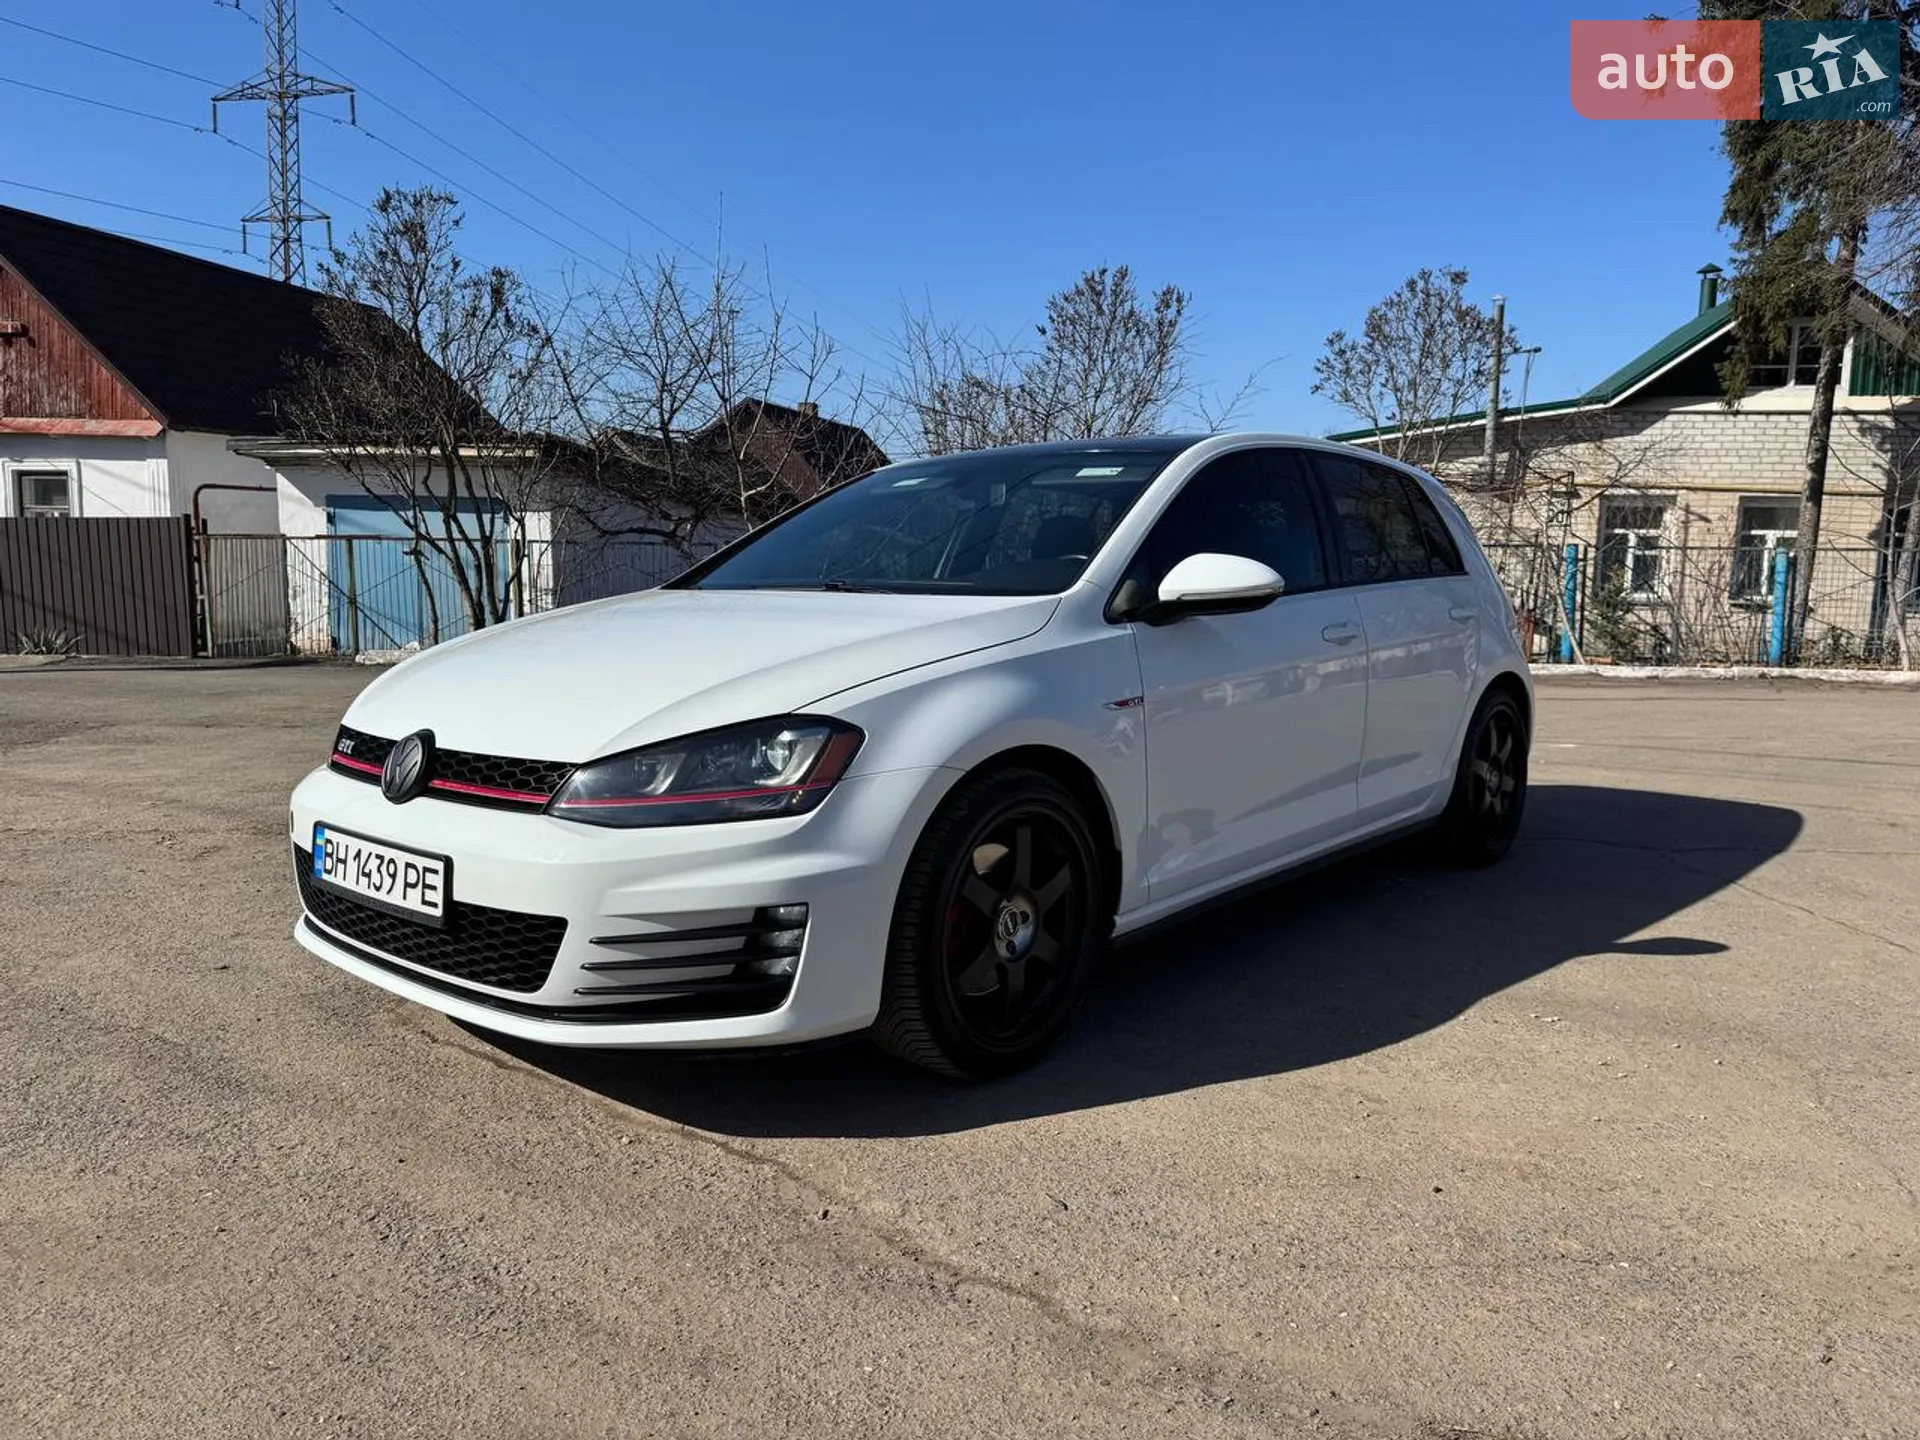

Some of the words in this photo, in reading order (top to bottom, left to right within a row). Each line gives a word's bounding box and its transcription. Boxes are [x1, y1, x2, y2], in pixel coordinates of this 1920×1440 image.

[338, 738, 355, 754] GTI
[323, 838, 349, 881] BH
[353, 848, 398, 895] 1439
[402, 861, 439, 909] PE
